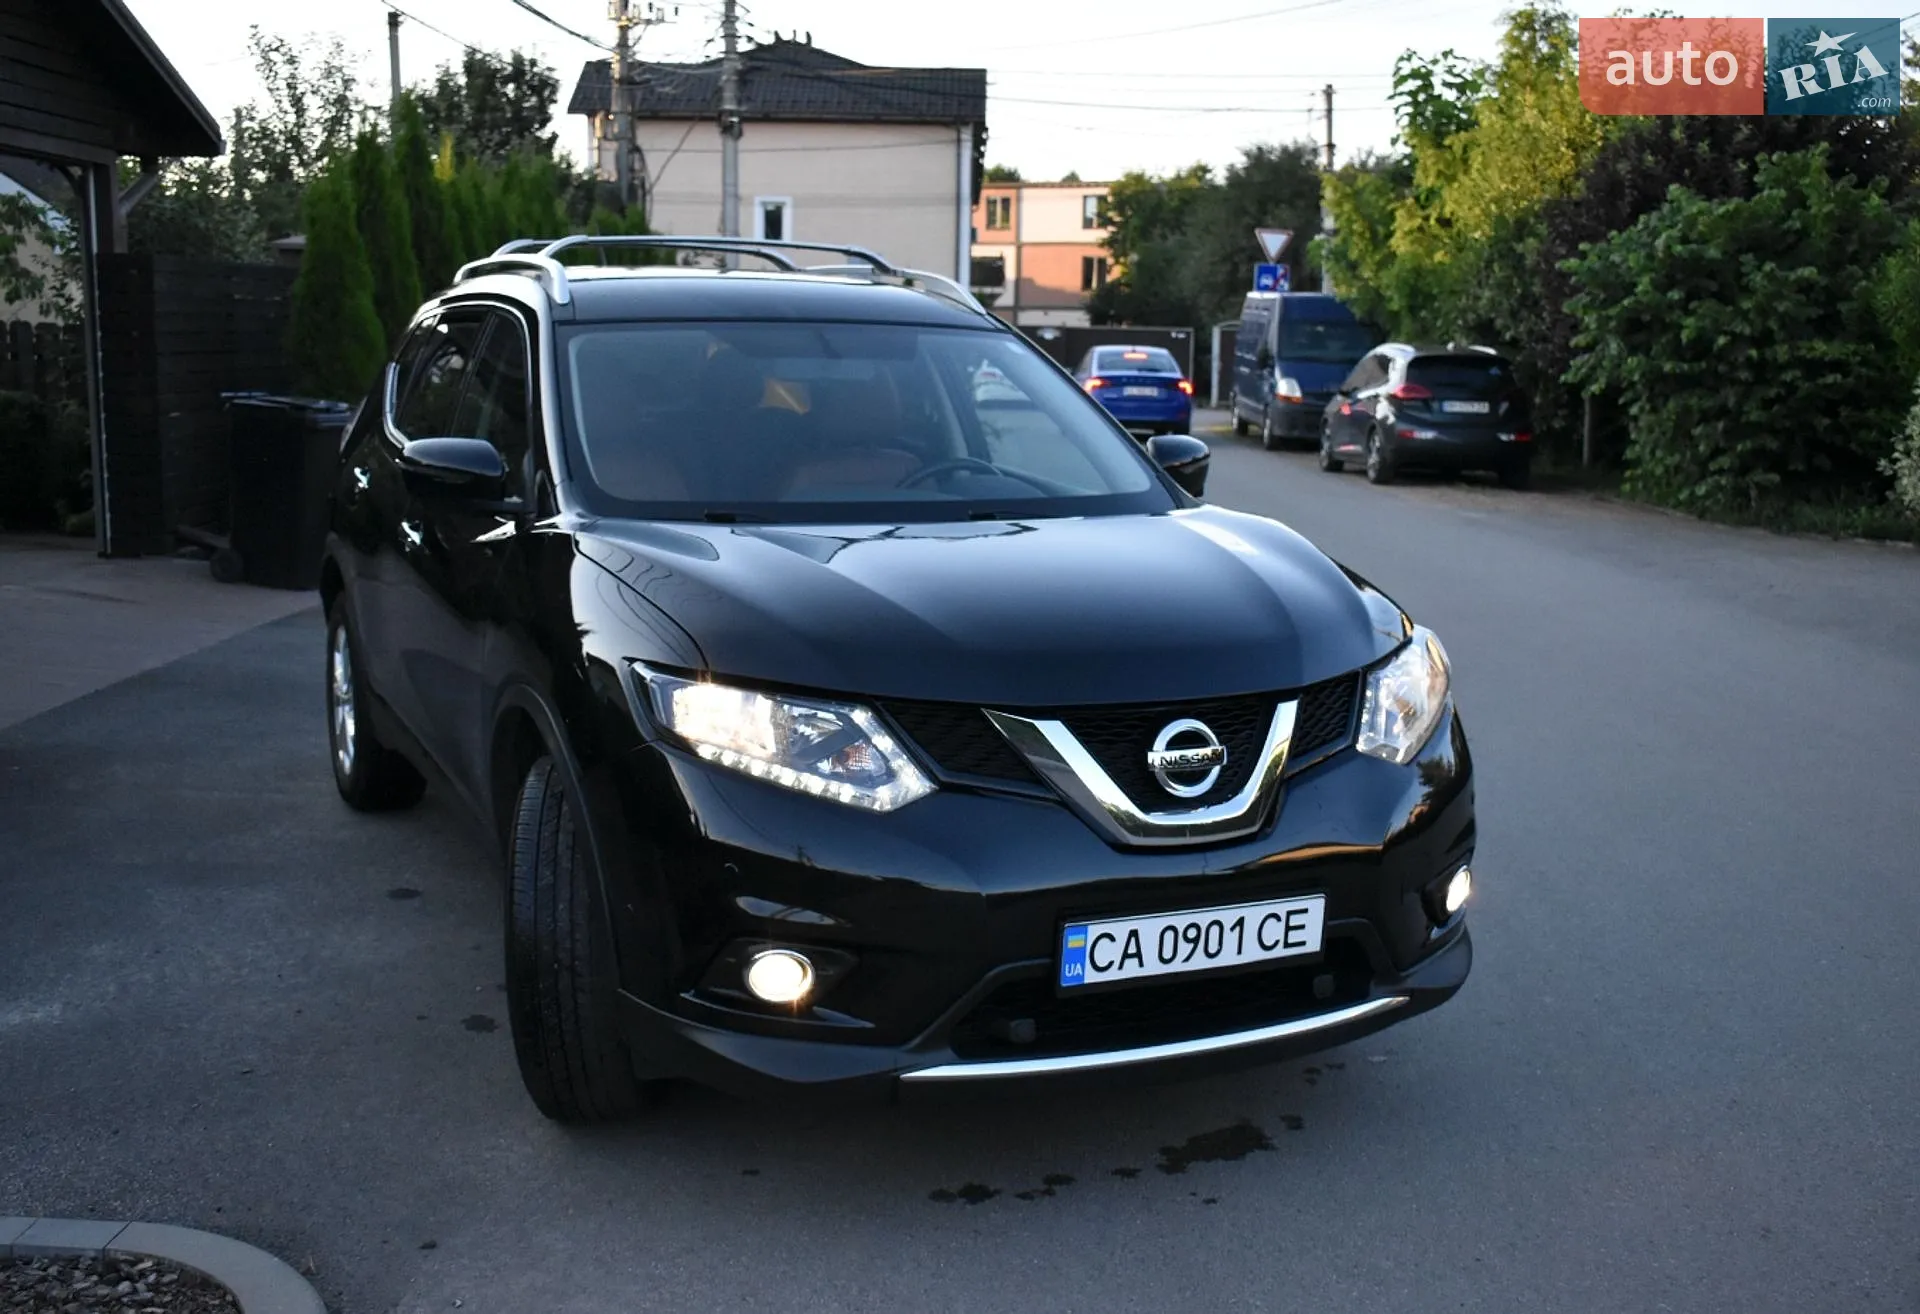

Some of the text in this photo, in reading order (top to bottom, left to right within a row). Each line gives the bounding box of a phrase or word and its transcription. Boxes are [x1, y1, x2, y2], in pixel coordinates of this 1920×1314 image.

[1158, 750, 1221, 767] NISSAN
[1089, 908, 1309, 973] CA 0901 CE
[1065, 963, 1083, 977] UA
